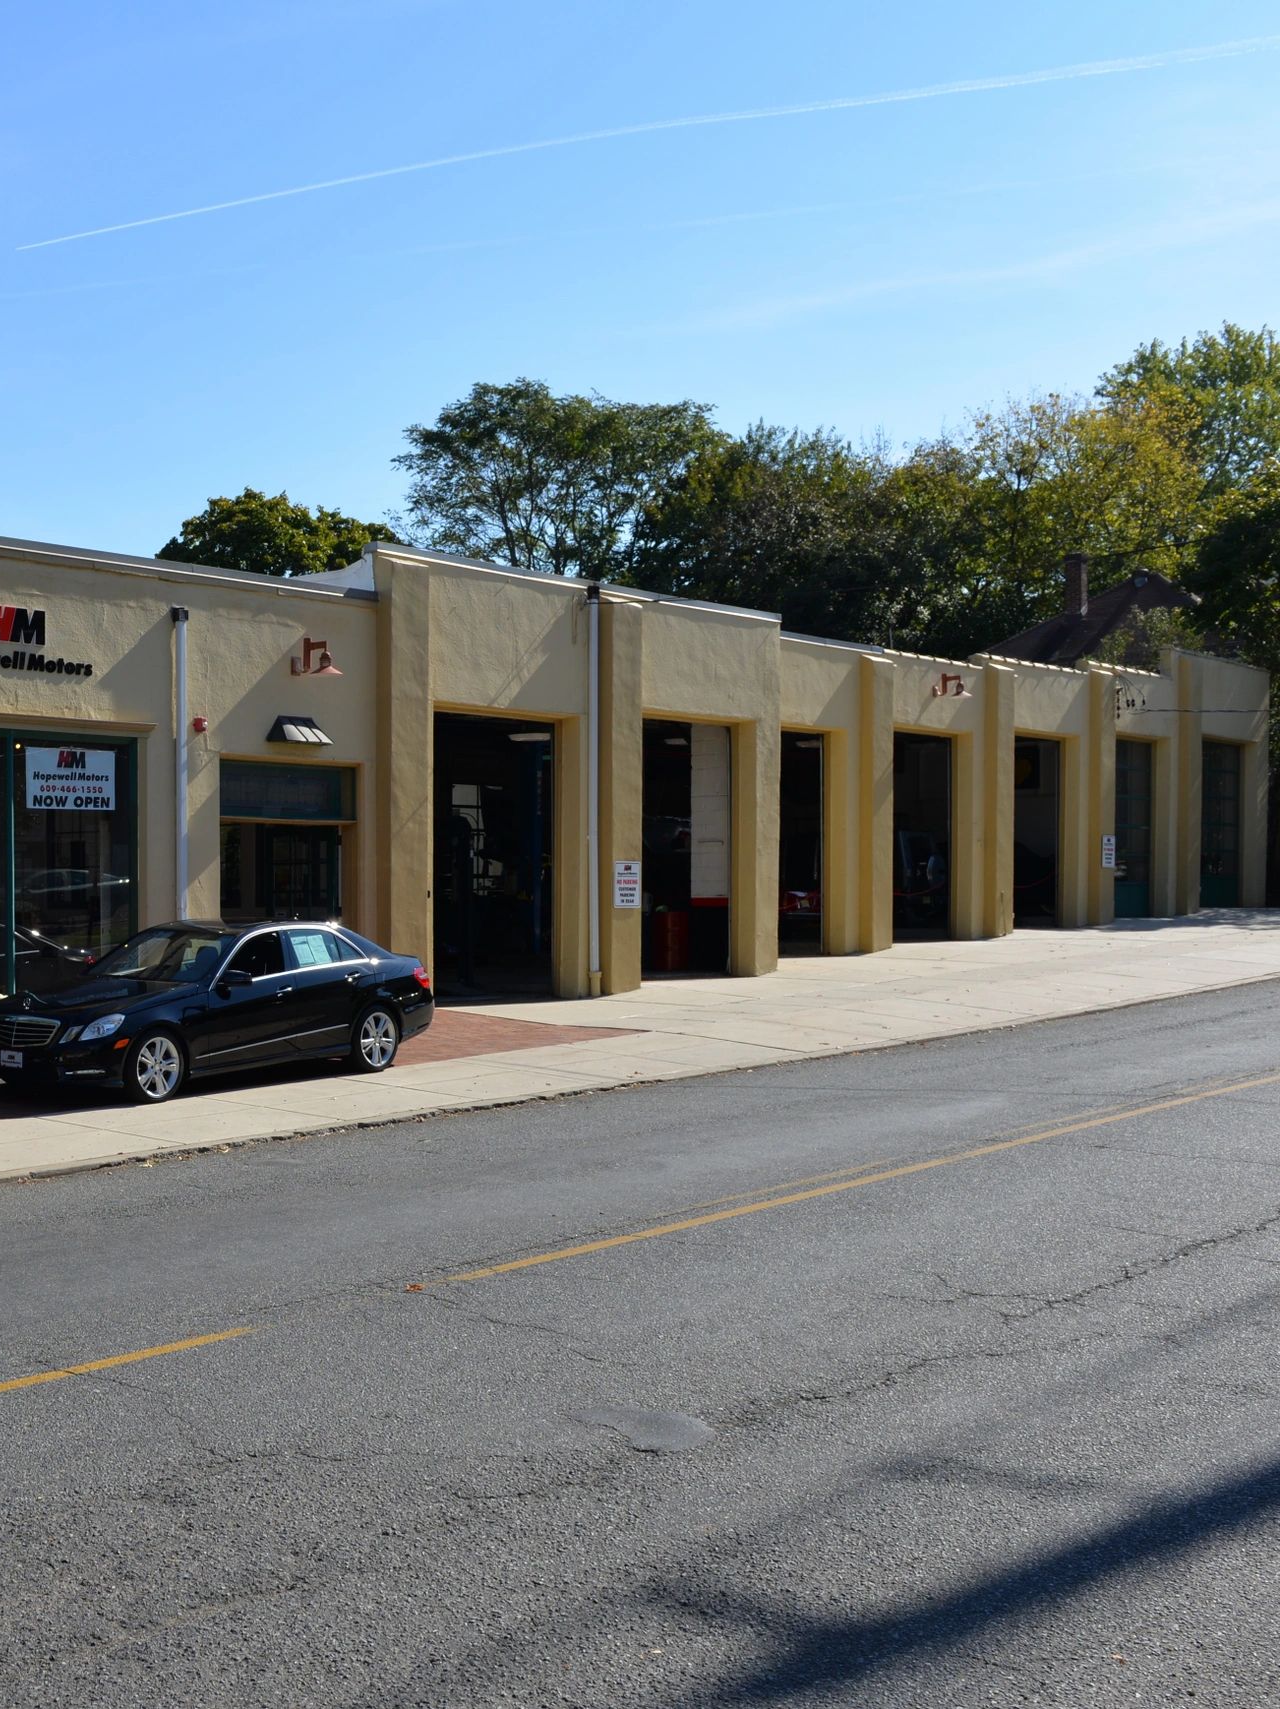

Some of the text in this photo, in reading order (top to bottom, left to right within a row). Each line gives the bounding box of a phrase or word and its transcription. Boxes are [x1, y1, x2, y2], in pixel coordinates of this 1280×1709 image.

[27, 653, 93, 677] Motors
[56, 750, 86, 769] HM
[33, 771, 110, 782] Hopewell Motors
[33, 795, 110, 808] NOW OPEN
